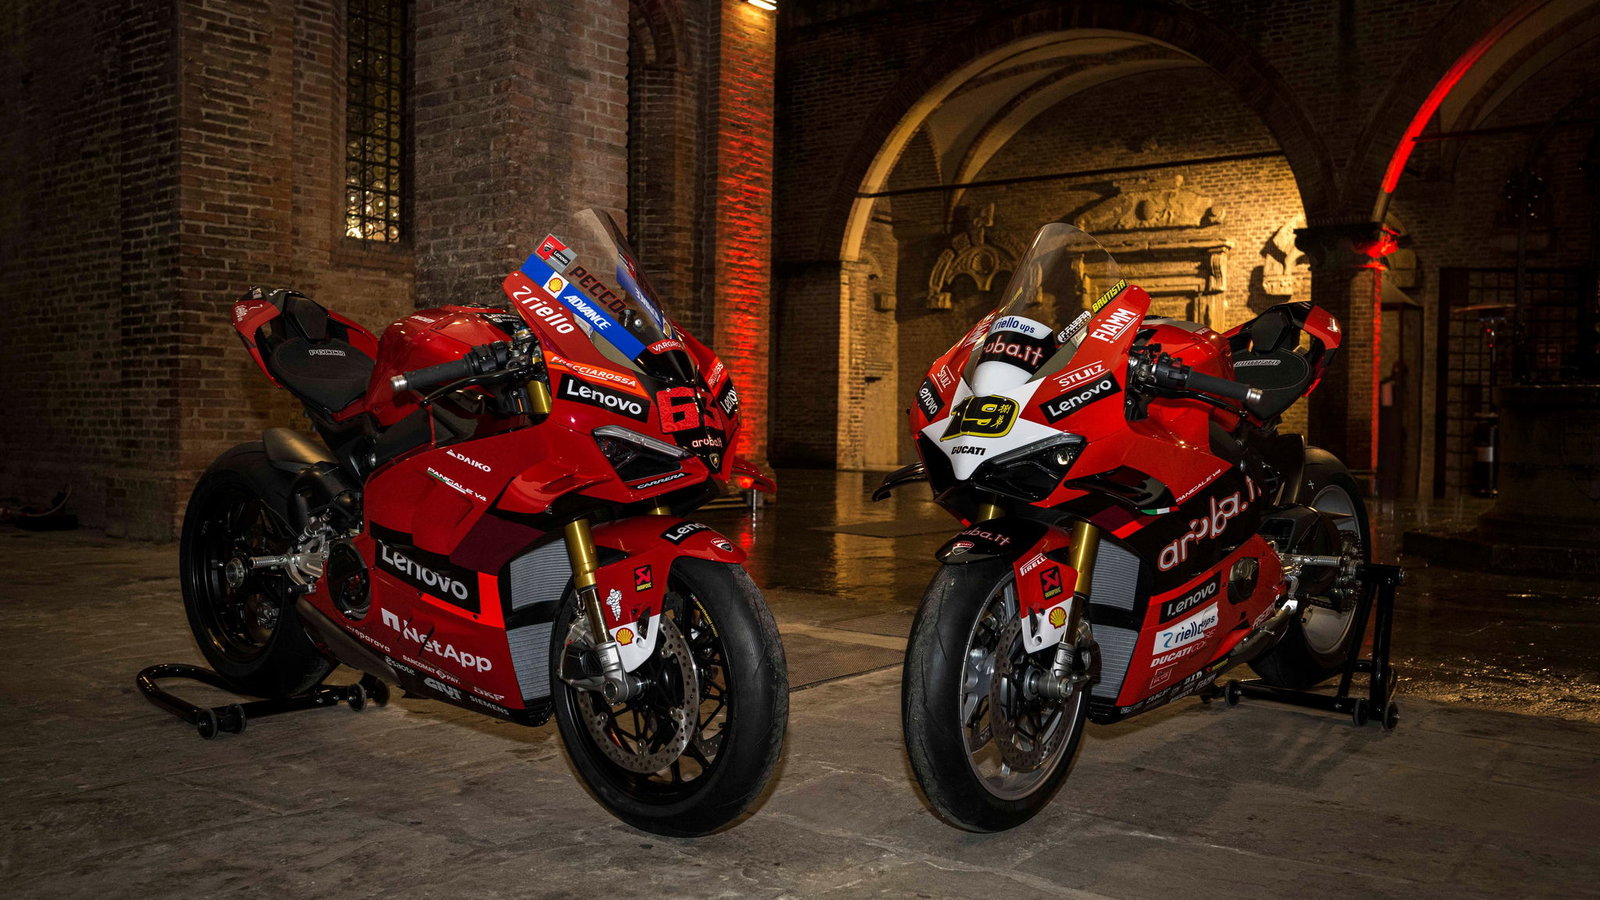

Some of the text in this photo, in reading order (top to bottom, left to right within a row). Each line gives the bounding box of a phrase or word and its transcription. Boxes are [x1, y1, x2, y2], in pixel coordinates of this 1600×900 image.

[569, 265, 630, 314] PECCO
[1092, 279, 1126, 312] BAUTISTA
[526, 297, 574, 334] riello
[564, 294, 612, 331] ADVANCE
[1019, 323, 1035, 333] ups
[1090, 308, 1136, 342] FIAMM
[984, 335, 1043, 366] uba.it
[551, 355, 636, 387] FRECCIAROSSA
[1058, 364, 1105, 387] STULZ
[566, 378, 642, 415] Lenovo
[656, 386, 723, 434] 63
[1047, 380, 1112, 417] Lenovo
[951, 445, 986, 456] DUCATI
[427, 467, 487, 502] PANIGALE V4
[637, 472, 685, 489] CARRERA
[377, 539, 468, 600] Lenovo
[1167, 582, 1216, 617] Lenovo
[403, 618, 492, 672] NetApp
[1150, 646, 1191, 668] DUCATI
